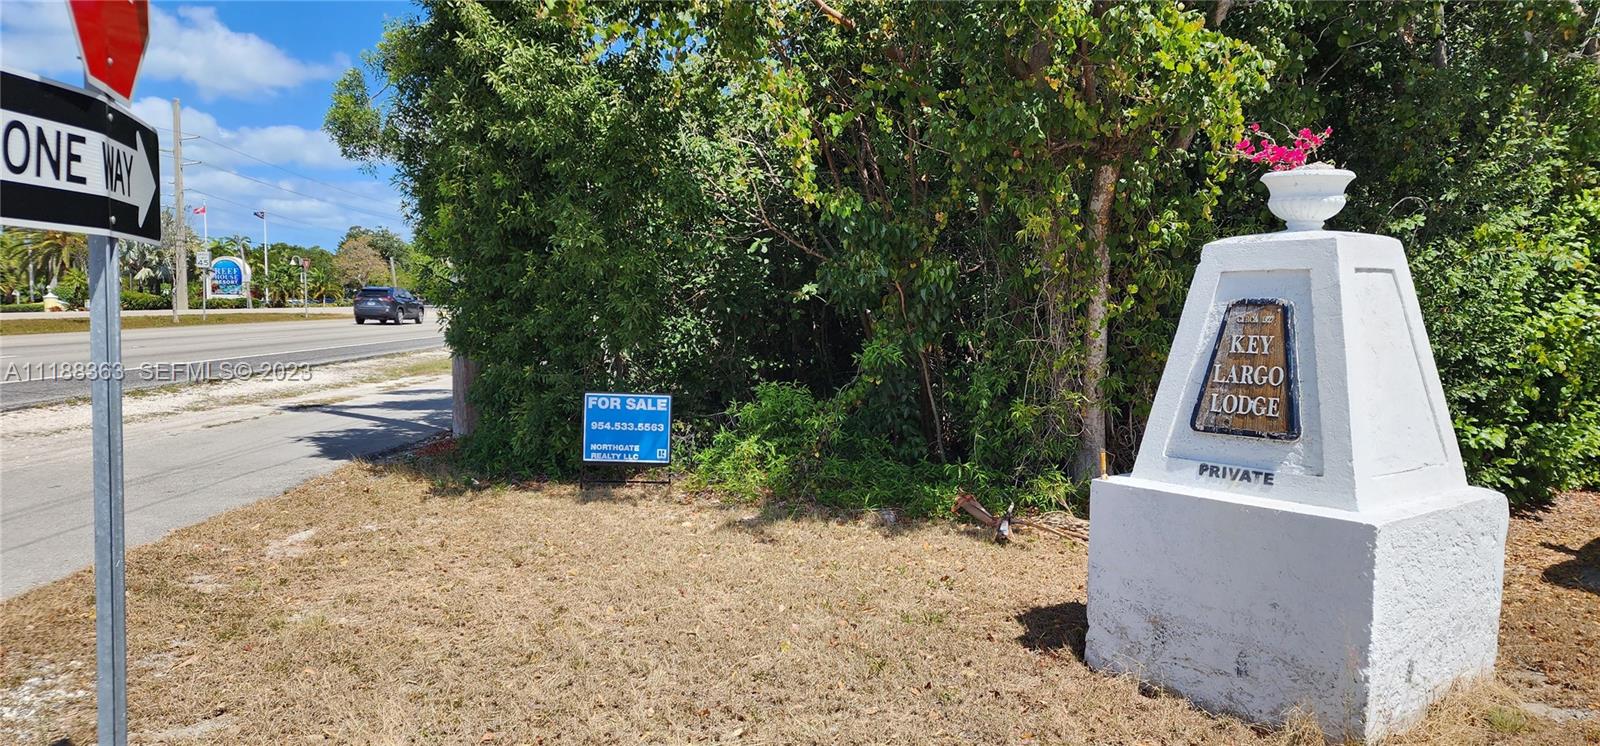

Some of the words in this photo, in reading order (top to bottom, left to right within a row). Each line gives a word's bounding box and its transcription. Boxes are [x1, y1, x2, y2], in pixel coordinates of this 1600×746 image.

[3, 120, 87, 185] ONE
[102, 141, 134, 197] WAY
[1229, 334, 1275, 355] KEY
[1213, 363, 1285, 387] LARGO
[588, 397, 621, 410] FOR
[626, 398, 668, 411] SALE
[1210, 393, 1280, 418] LODGE
[591, 422, 664, 431] 954.533.5563
[1199, 463, 1275, 486] PRIVATE
